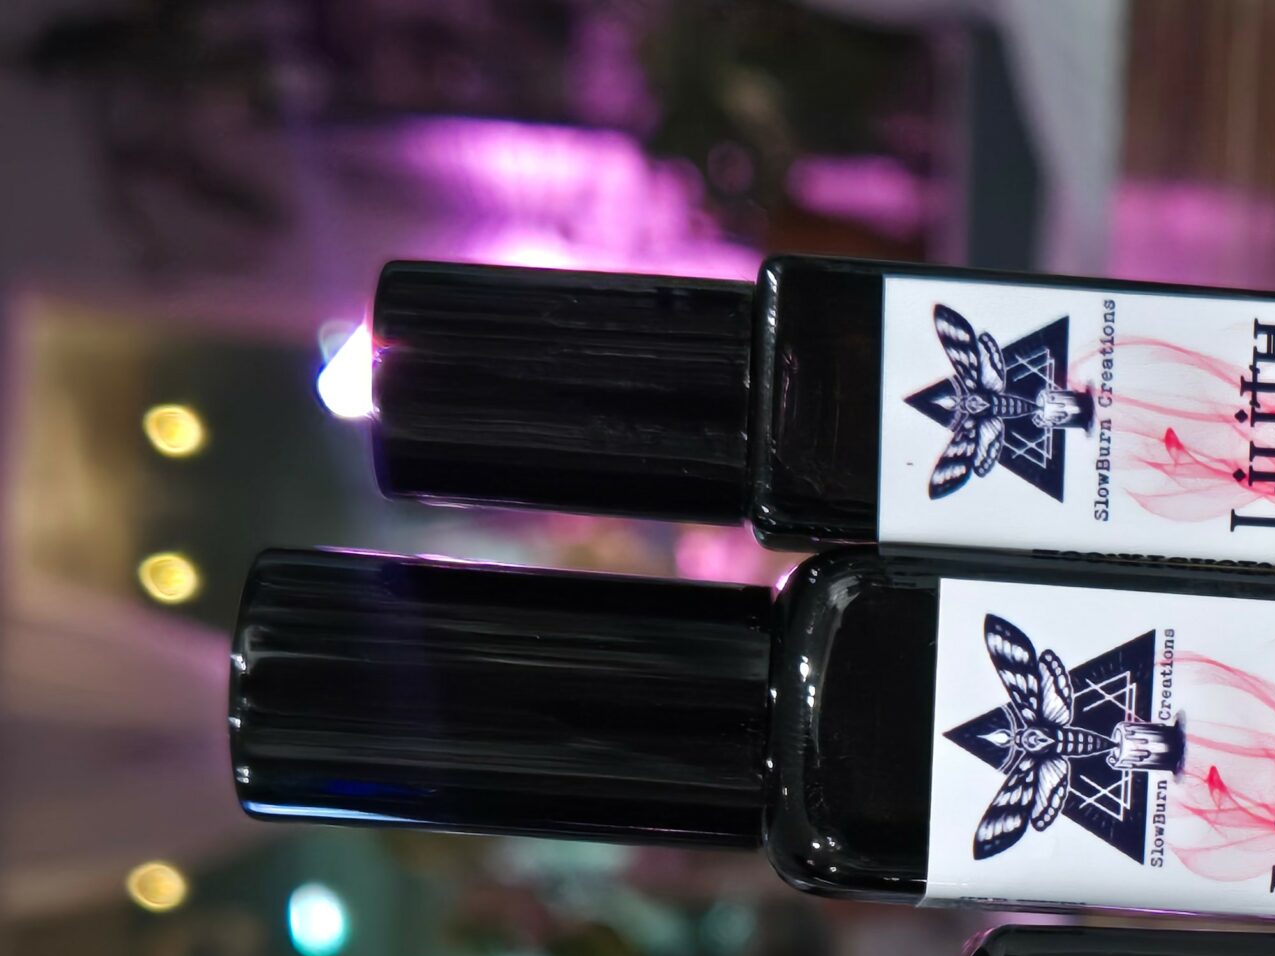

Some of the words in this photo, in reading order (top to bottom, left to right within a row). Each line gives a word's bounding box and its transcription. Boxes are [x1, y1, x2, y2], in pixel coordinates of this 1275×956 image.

[1098, 300, 1116, 408] Creations
[1094, 418, 1112, 522] SlowBurn
[1157, 628, 1176, 720] Creations
[1150, 779, 1168, 868] SlowBurn
